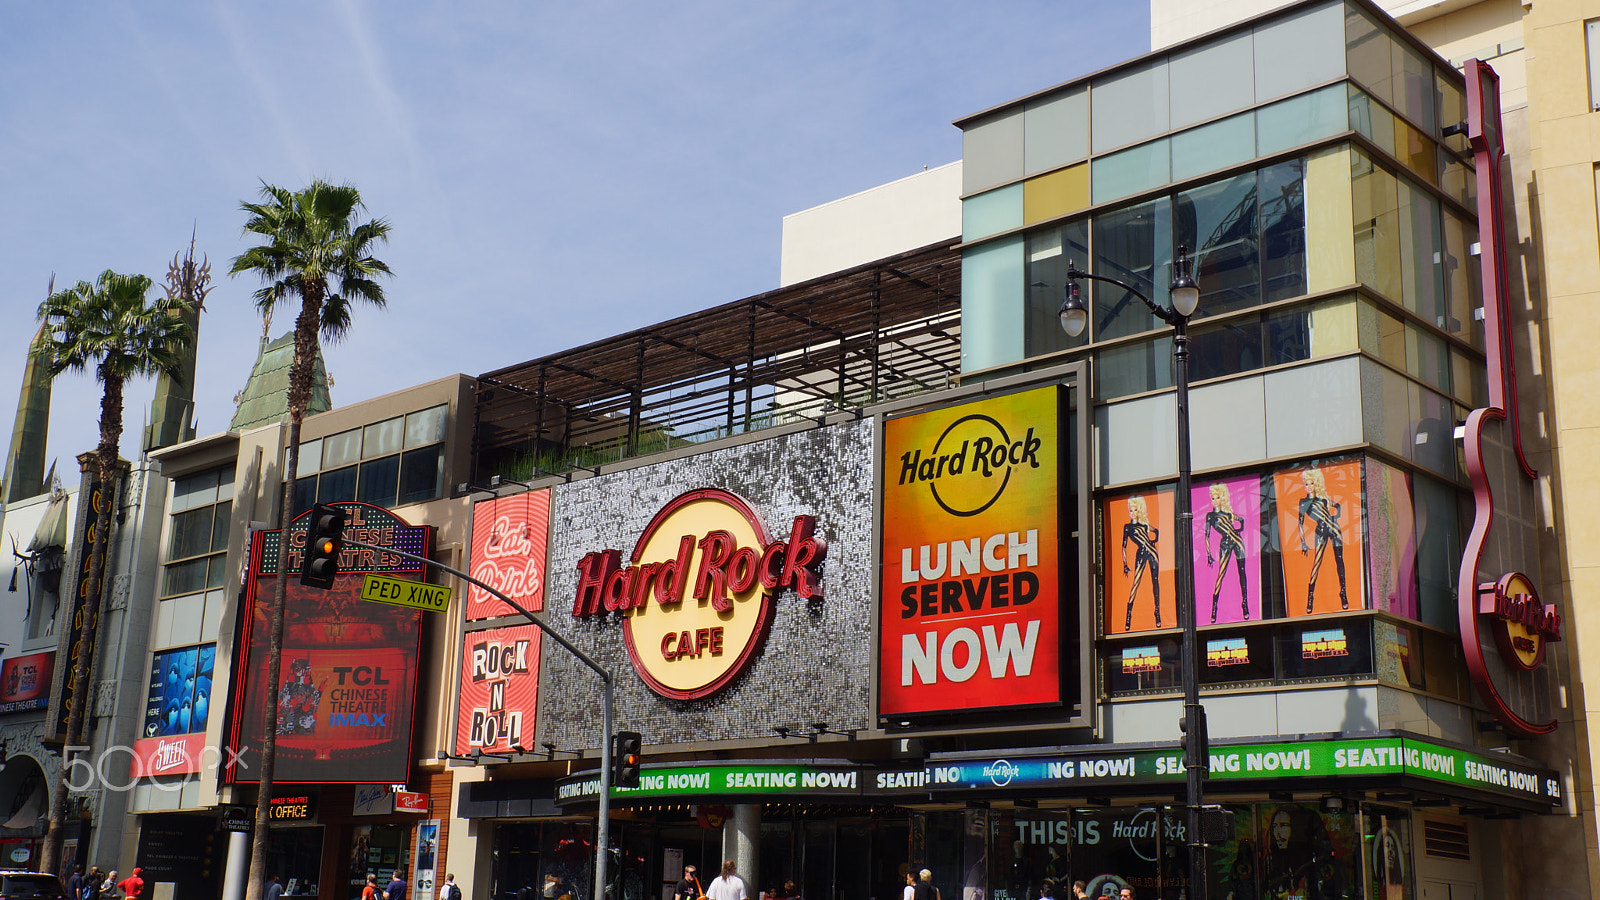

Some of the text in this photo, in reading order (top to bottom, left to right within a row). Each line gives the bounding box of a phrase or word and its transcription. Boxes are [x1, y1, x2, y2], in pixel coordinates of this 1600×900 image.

[899, 427, 1042, 486] Hard Rock
[290, 527, 394, 548] CNESE
[287, 548, 403, 569] THATRES
[572, 514, 827, 618] Hard Rock
[901, 528, 1039, 584] LUNCH
[472, 558, 540, 603] Drink
[368, 579, 445, 607] PED XING
[900, 570, 1040, 619] SERVED
[660, 627, 724, 660] CAFE
[900, 620, 1042, 687] NOW
[23, 665, 37, 674] TCL
[472, 640, 531, 682] ROCK
[333, 666, 390, 686] TCL
[330, 689, 389, 701] CHINESE
[330, 701, 387, 713] THEATRE
[329, 713, 387, 726] IMAX
[469, 708, 523, 748] ROLL
[983, 765, 1019, 777] Hard Rock
[1080, 757, 1136, 778] NOW!
[1155, 749, 1311, 775] SEANG NOW!
[1334, 746, 1455, 777] SEATING NOW!
[667, 772, 710, 790] NOW!
[726, 771, 857, 789] SEATING NOW!
[1464, 760, 1539, 794] SEATING NOW!
[391, 784, 408, 793] TCL
[558, 779, 602, 799] SEATING NOW
[275, 804, 308, 818] OFFICE
[1015, 820, 1068, 845] THIS
[1077, 820, 1101, 845] IS
[1112, 820, 1150, 838] Hard
